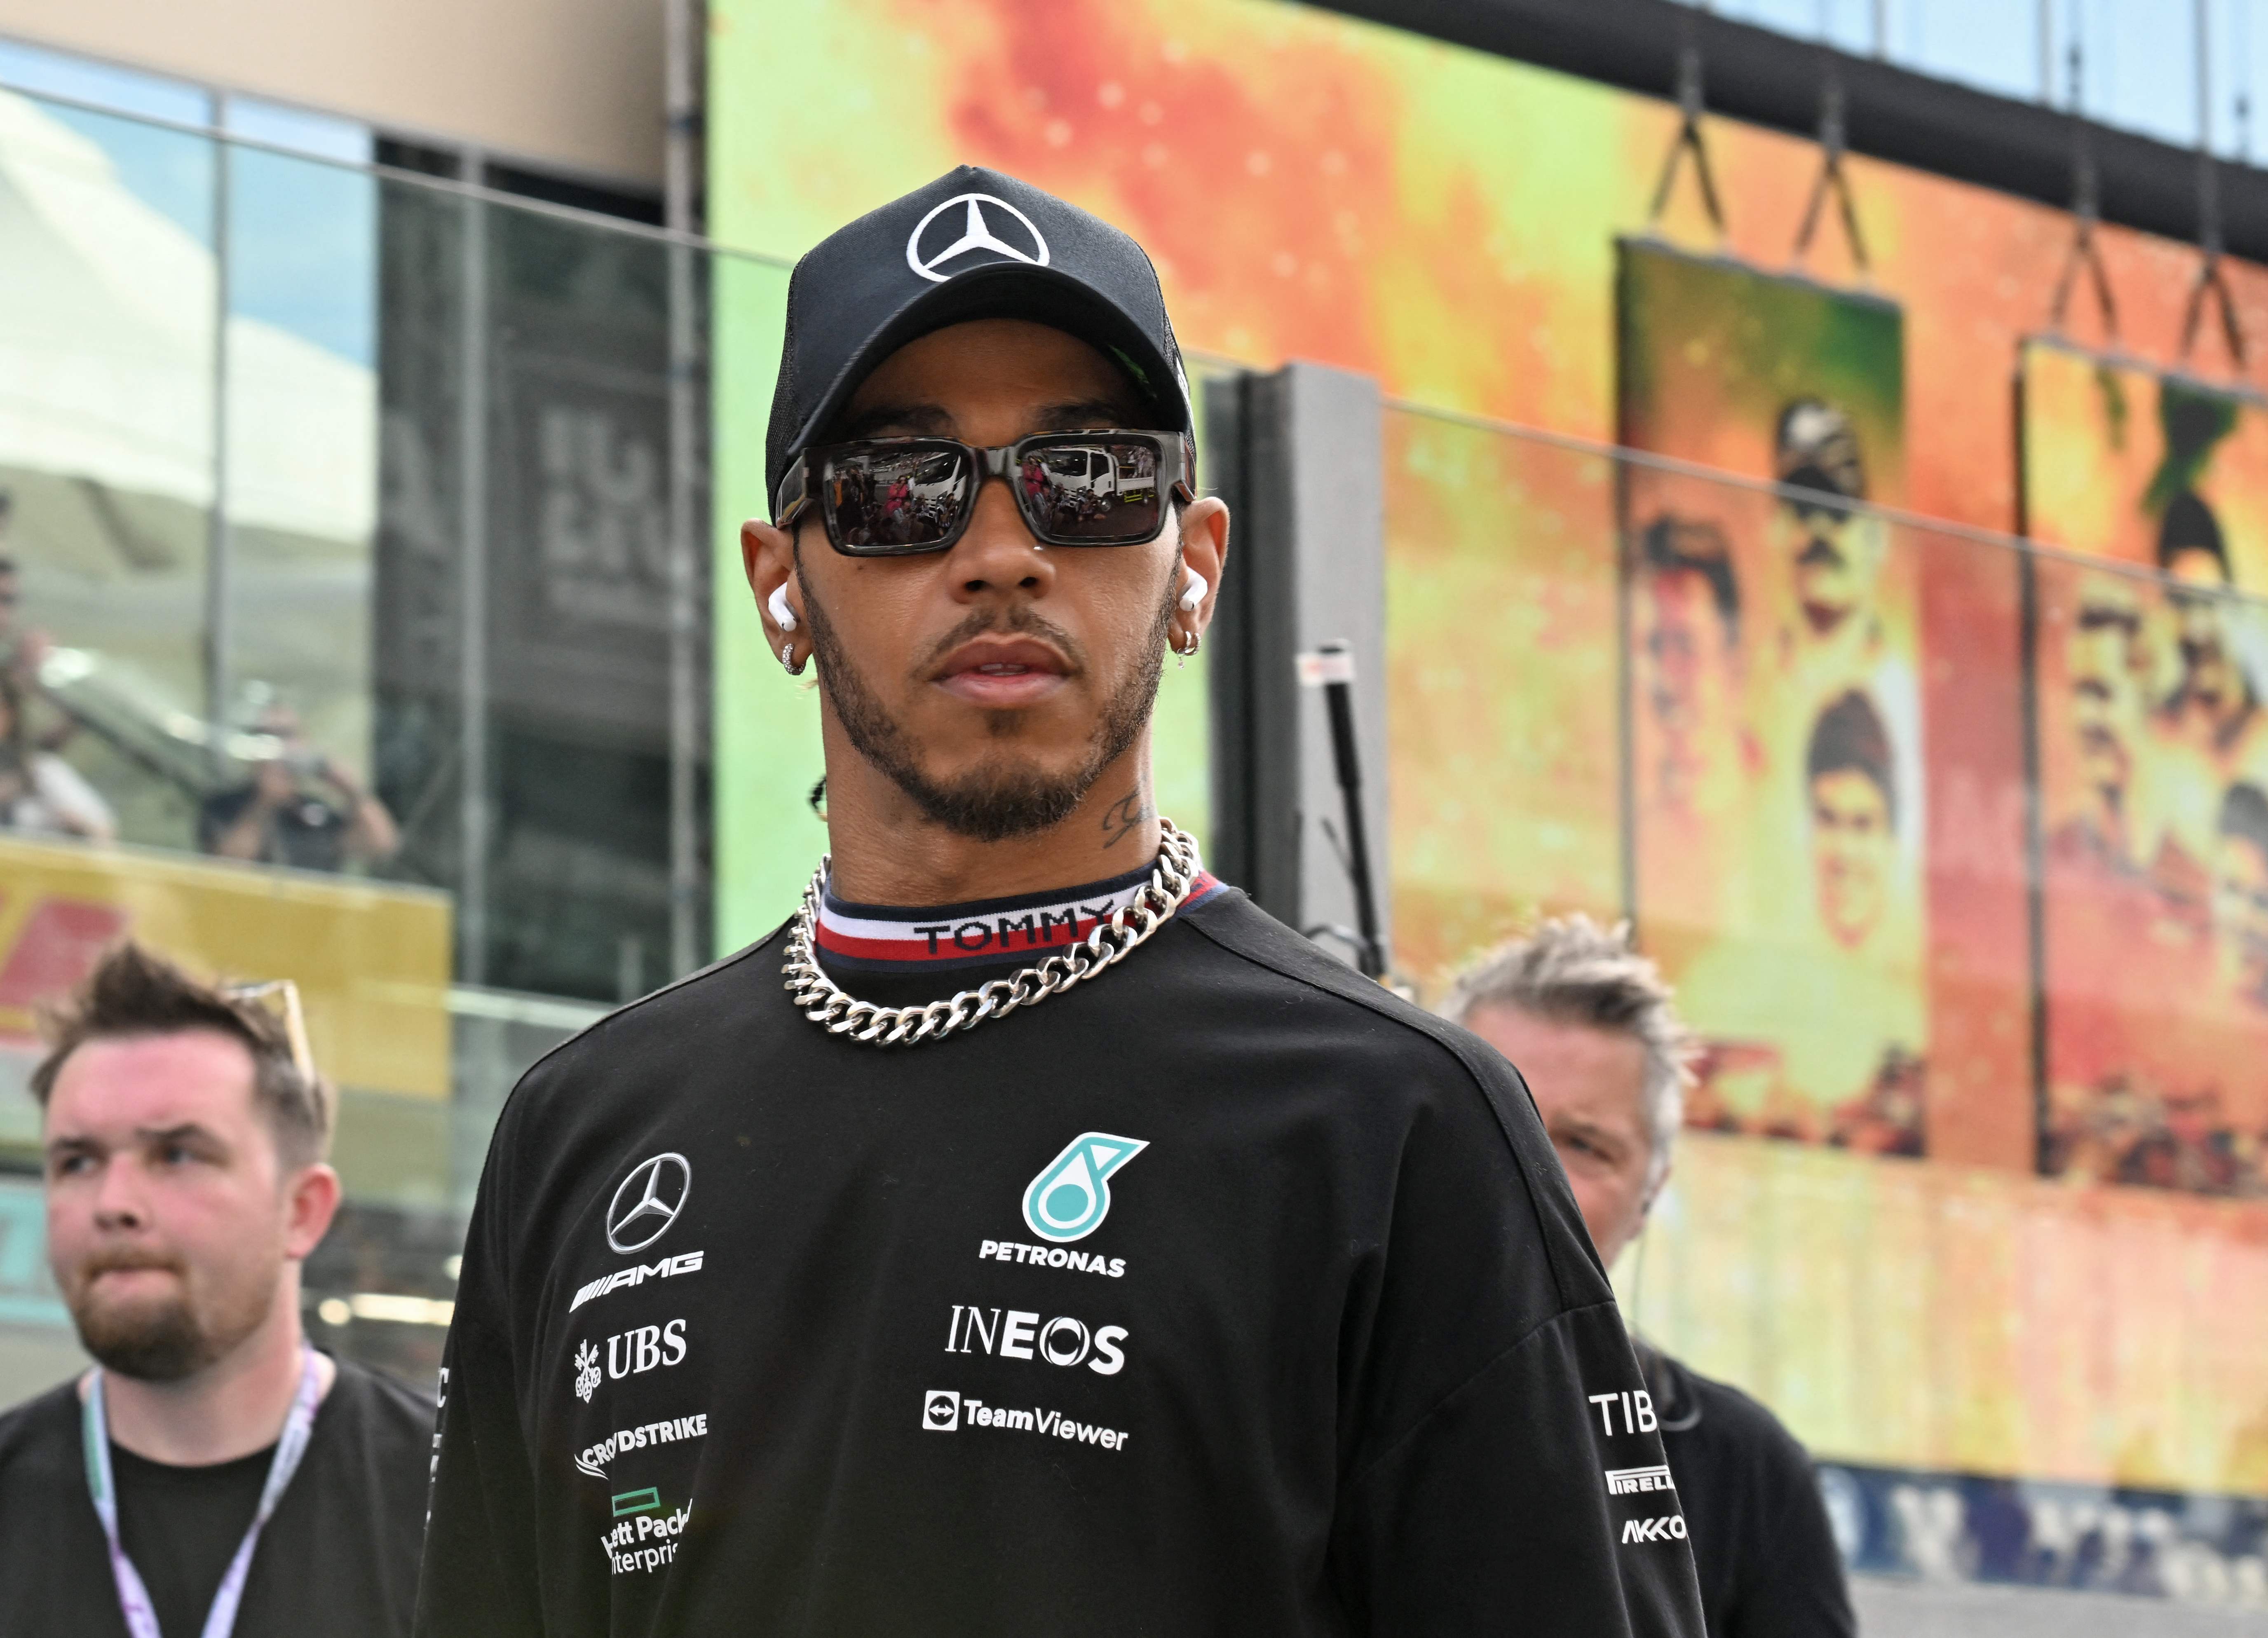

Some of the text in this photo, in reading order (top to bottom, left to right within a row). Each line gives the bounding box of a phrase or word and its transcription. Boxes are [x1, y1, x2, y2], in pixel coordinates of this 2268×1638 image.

[914, 899, 1114, 954] TOMMY
[602, 1250, 704, 1295] AMG
[979, 1240, 1126, 1278] PETRONAS
[607, 1319, 687, 1379] UBS
[945, 1305, 1129, 1375] INEOS
[964, 1399, 1128, 1451] TeamViewer
[1588, 1390, 1658, 1436] TIB
[636, 1498, 693, 1541] Pack
[1621, 1515, 1689, 1544] AKKO
